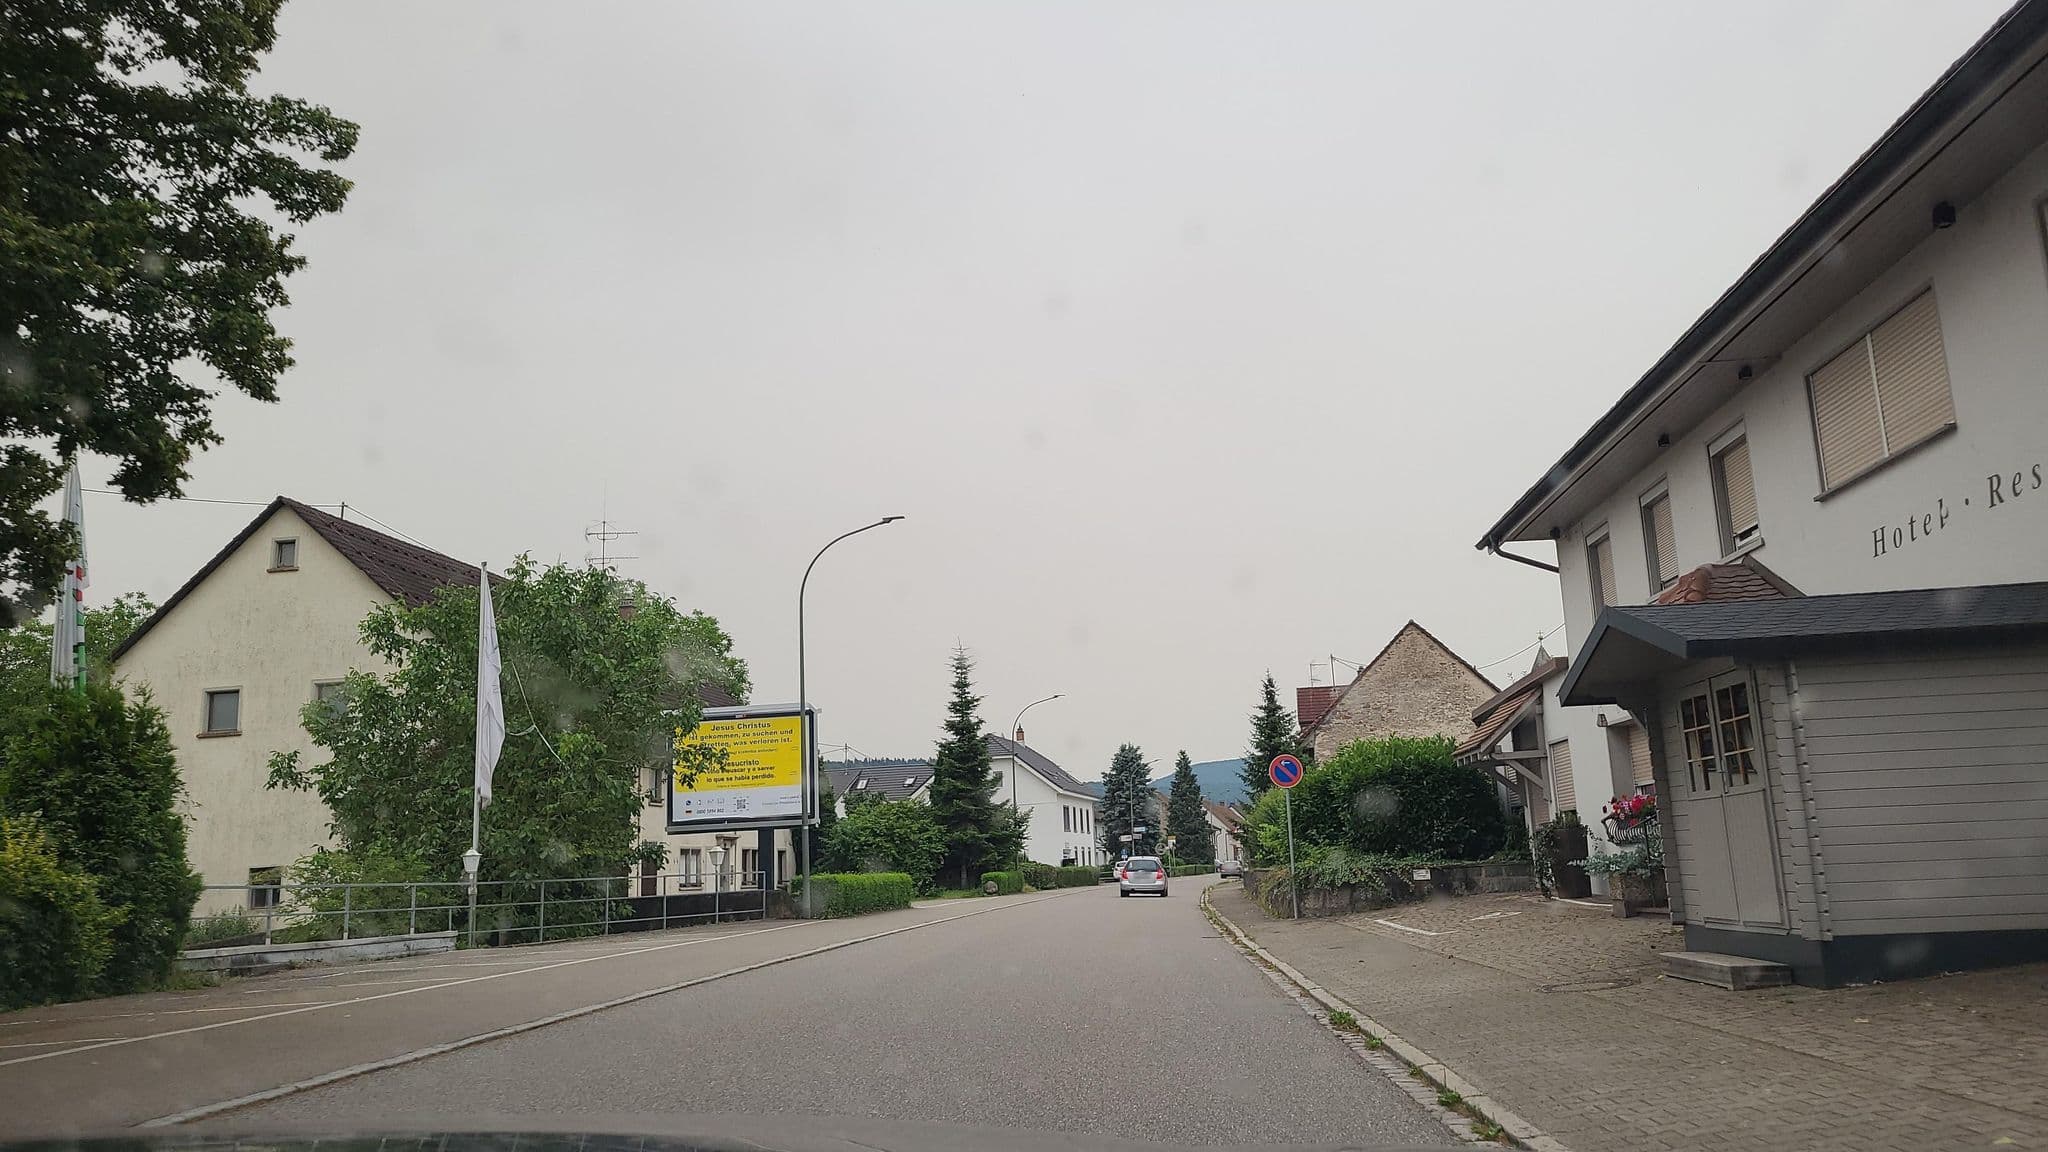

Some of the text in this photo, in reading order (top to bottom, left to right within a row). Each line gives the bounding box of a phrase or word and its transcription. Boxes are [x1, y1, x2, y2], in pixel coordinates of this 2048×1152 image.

[1871, 463, 2043, 558] Hotel Res
[711, 722, 771, 731] Jesus Christus
[699, 732, 741, 742] gekommen,
[752, 729, 778, 737] suchen
[779, 728, 793, 736] und
[749, 737, 779, 745] verloren
[780, 736, 793, 744] ist.
